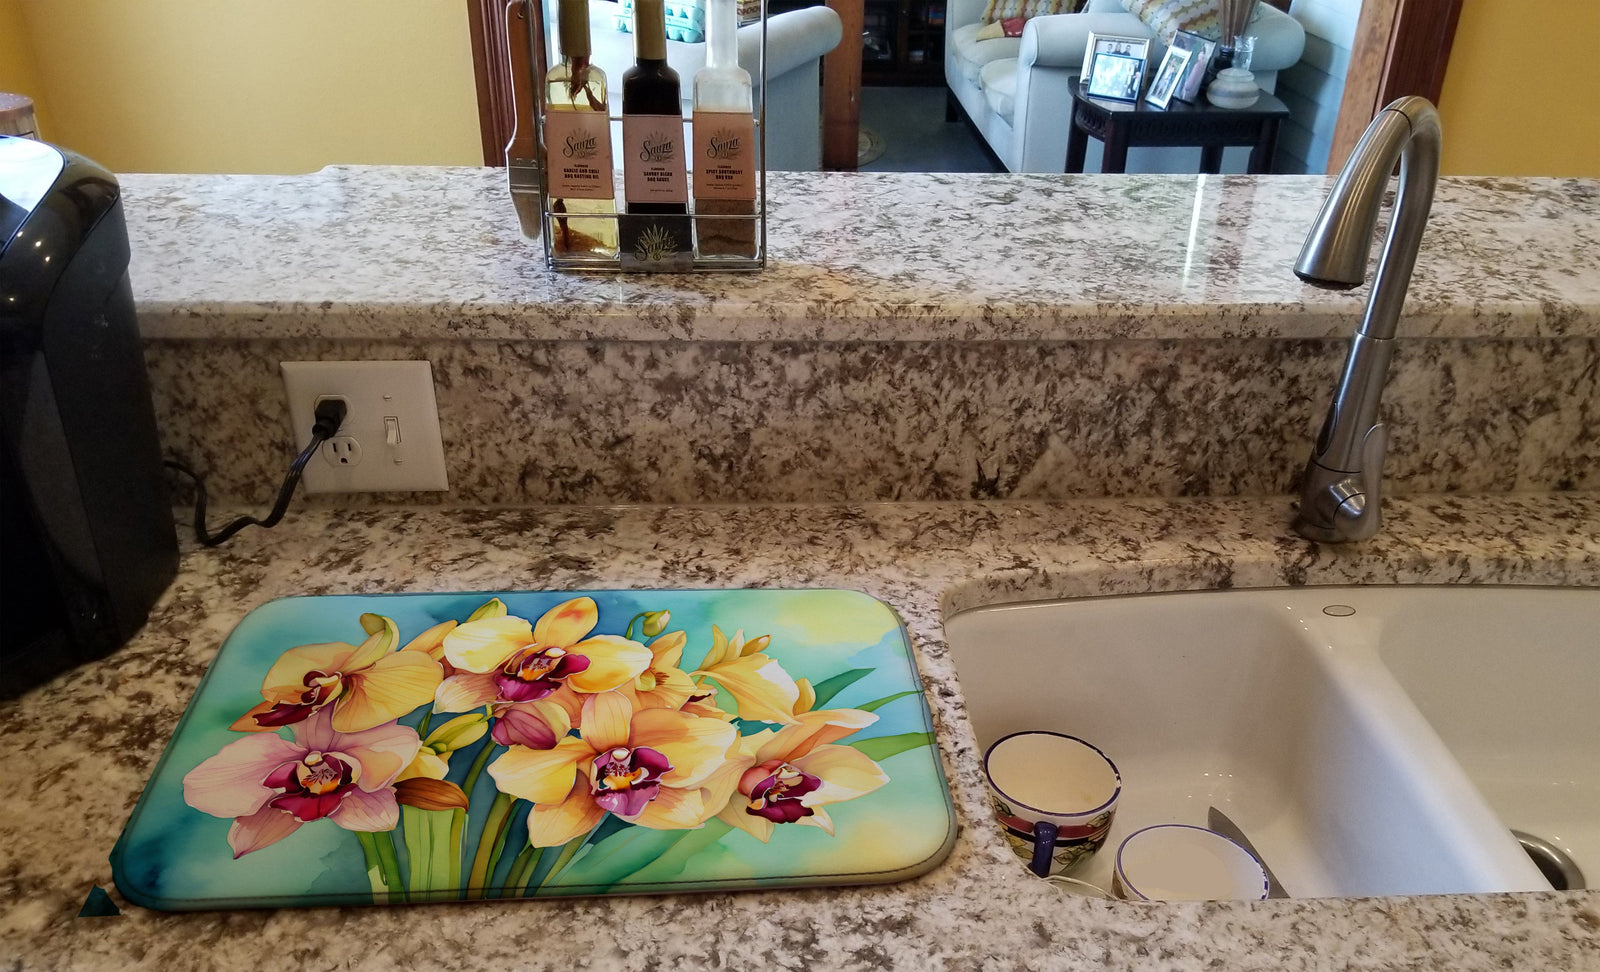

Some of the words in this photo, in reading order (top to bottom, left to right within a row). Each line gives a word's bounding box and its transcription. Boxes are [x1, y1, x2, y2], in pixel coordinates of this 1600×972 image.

[563, 136, 597, 158] Sauza
[640, 140, 673, 161] Sauza
[707, 136, 740, 158] Sauza
